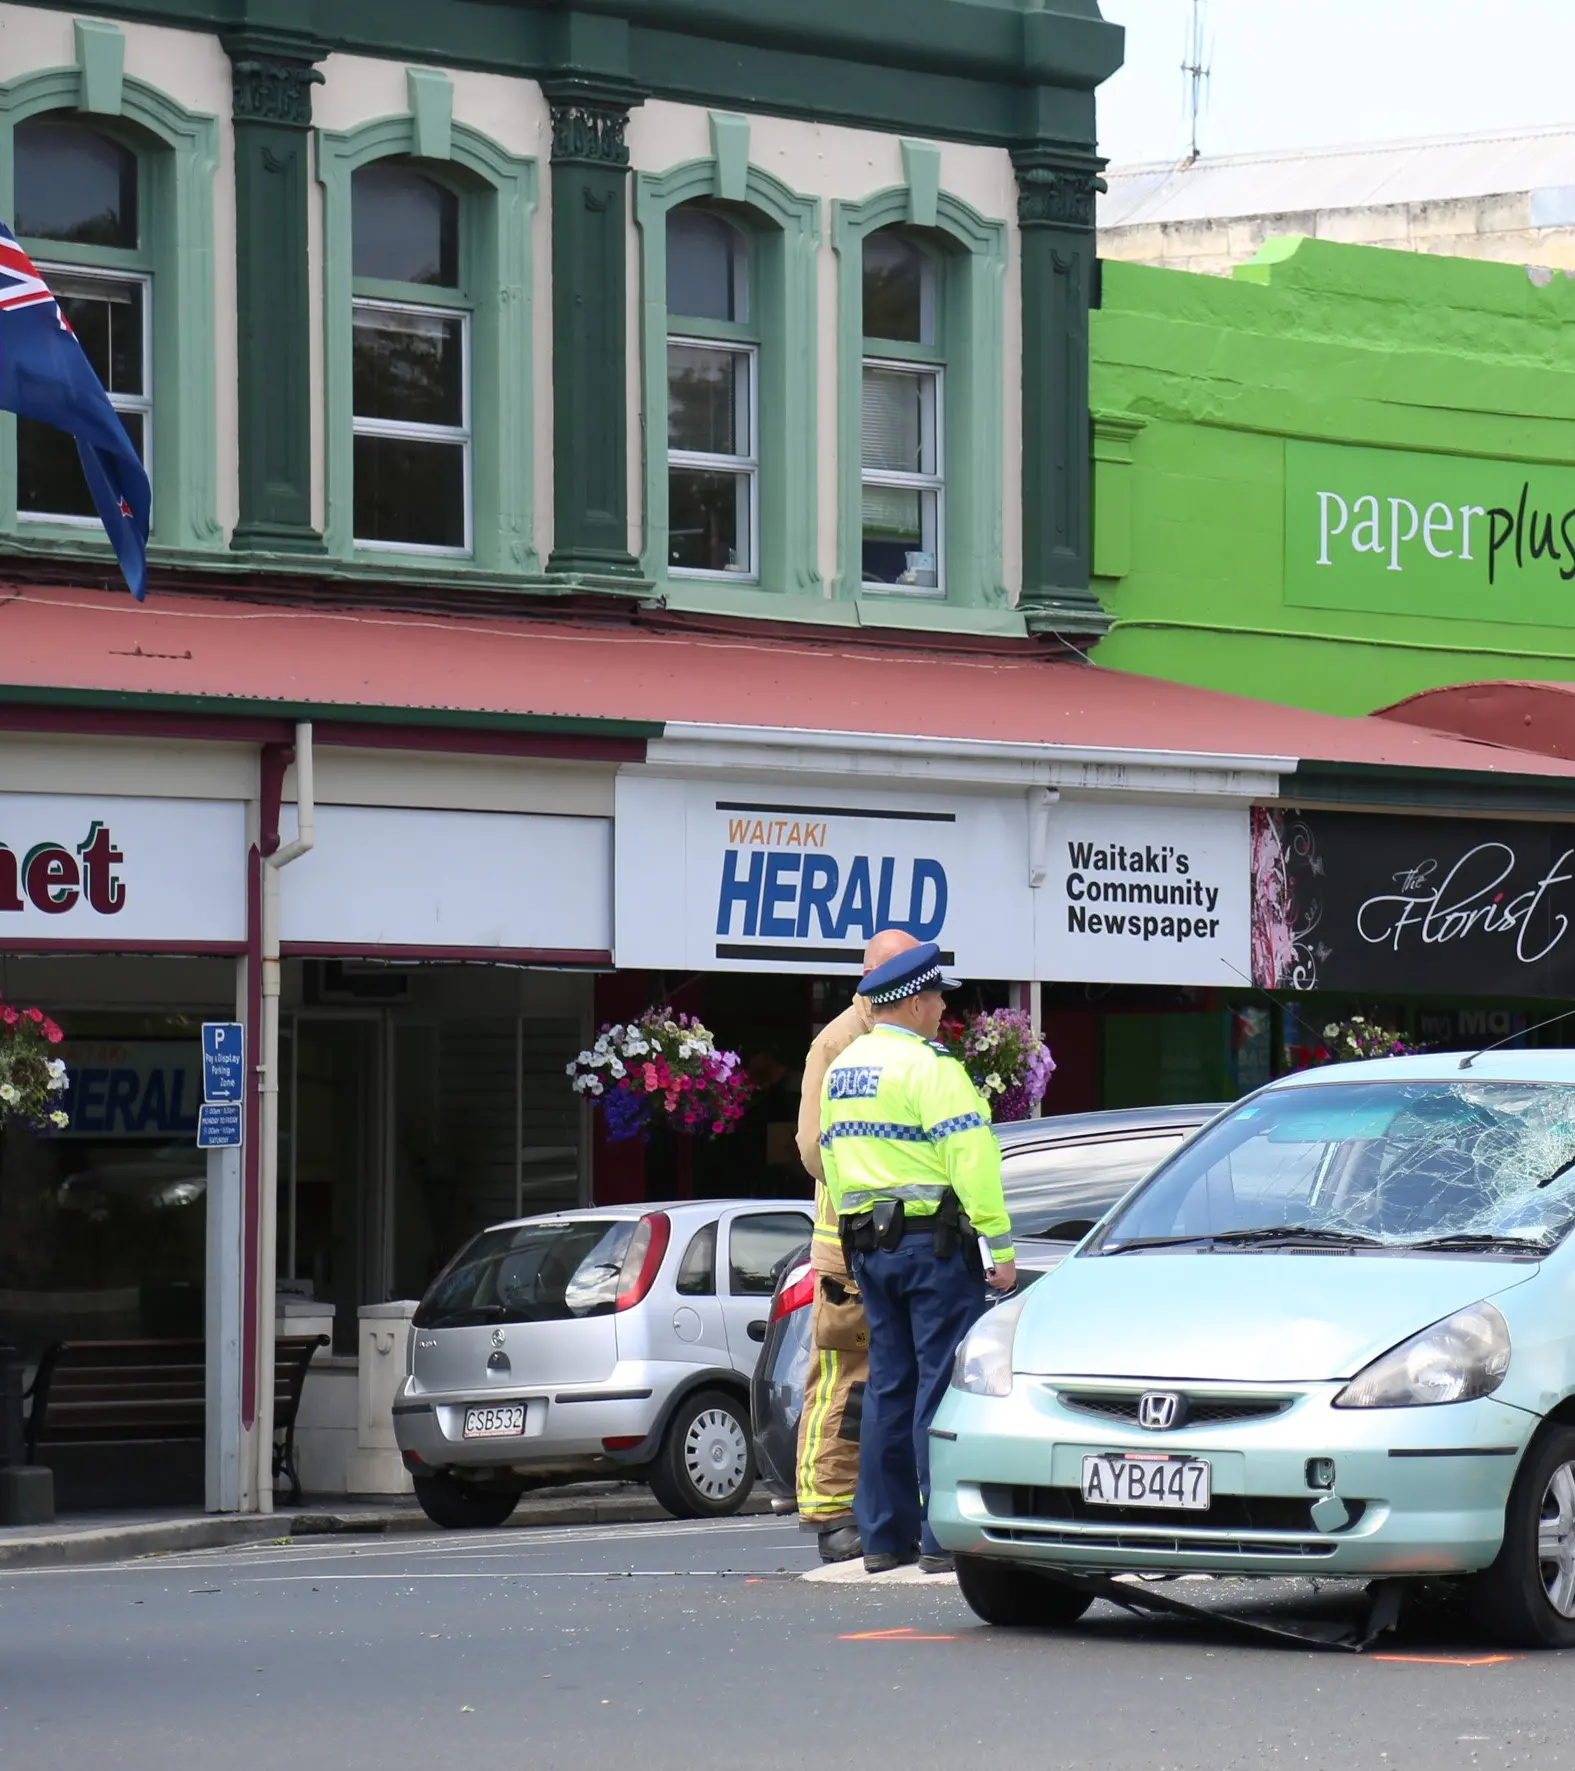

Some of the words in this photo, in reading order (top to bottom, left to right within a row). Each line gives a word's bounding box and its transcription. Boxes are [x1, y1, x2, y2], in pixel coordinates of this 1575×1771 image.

[727, 818, 827, 848] WAITAKI
[1068, 841, 1189, 874] Waitaki's
[716, 850, 948, 942] HERALD
[1066, 873, 1219, 912] Community
[1357, 841, 1575, 962] Florist
[1068, 906, 1220, 942] Newspaper
[215, 1028, 225, 1049] P
[205, 1053, 214, 1064] Pay
[218, 1053, 240, 1064] Display
[212, 1065, 230, 1076] Parking
[220, 1077, 235, 1087] Zone
[829, 1069, 880, 1098] POLICE
[467, 1408, 524, 1431] CSB532
[1088, 1460, 1204, 1502] AYB447
